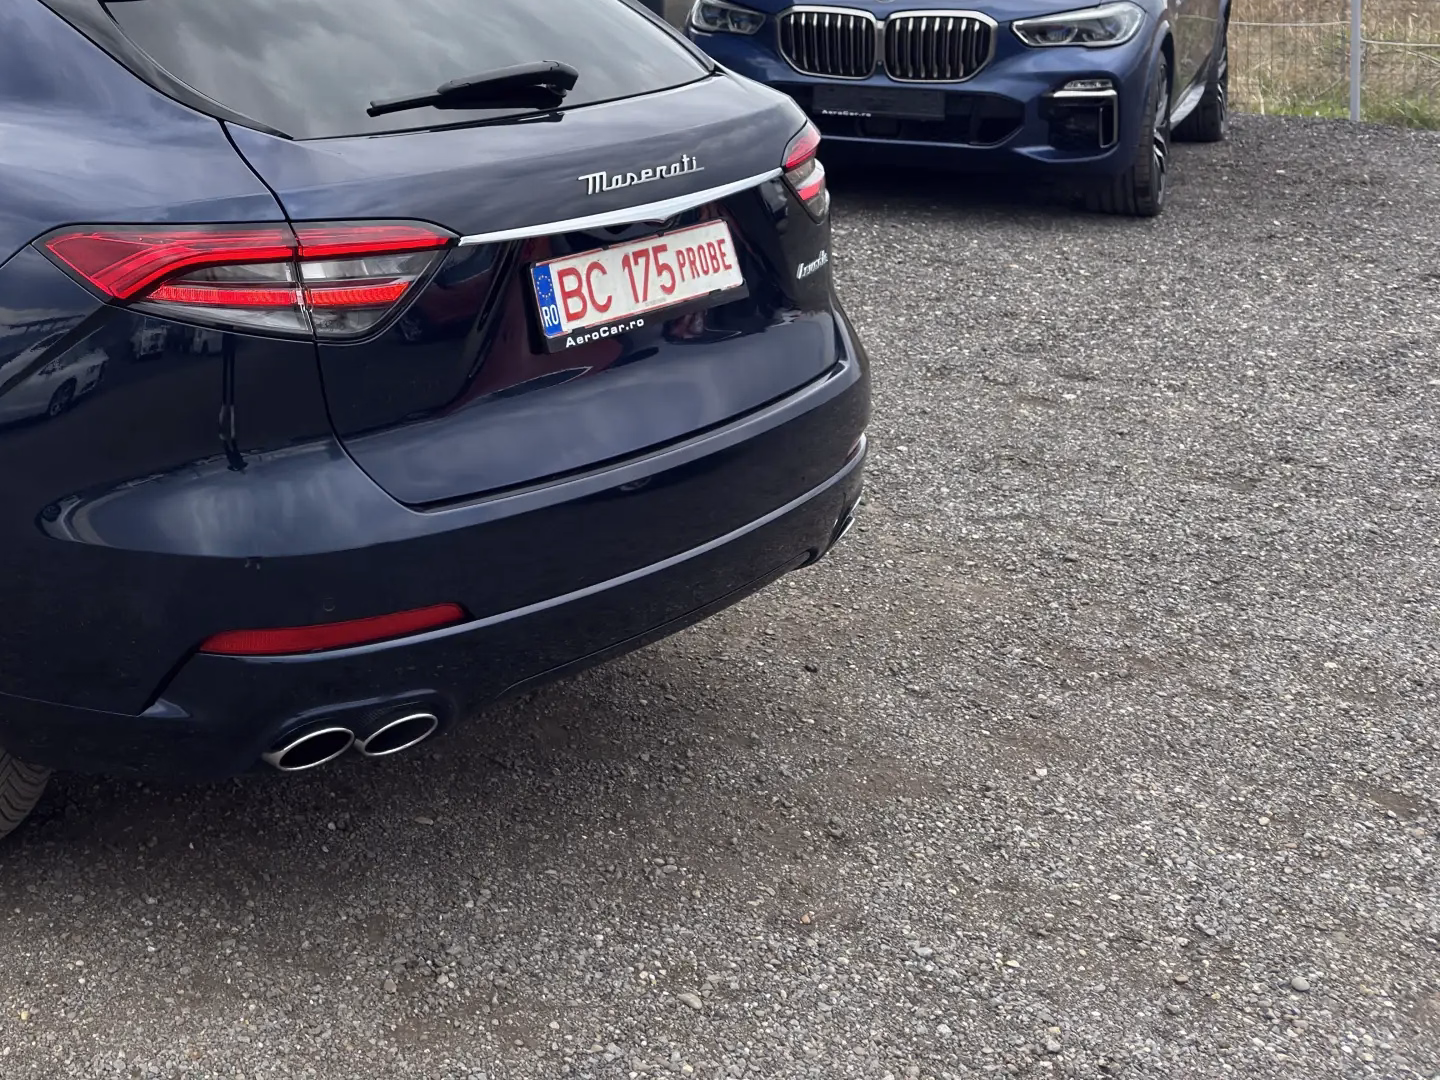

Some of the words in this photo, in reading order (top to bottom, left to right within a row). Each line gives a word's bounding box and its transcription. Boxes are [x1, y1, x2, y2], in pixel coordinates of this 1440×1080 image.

[577, 154, 705, 195] Maserati
[557, 261, 613, 323] BC
[621, 244, 677, 304] 175
[675, 238, 732, 282] PROBE
[542, 304, 560, 328] RO
[565, 318, 645, 348] AeroCar.ro
